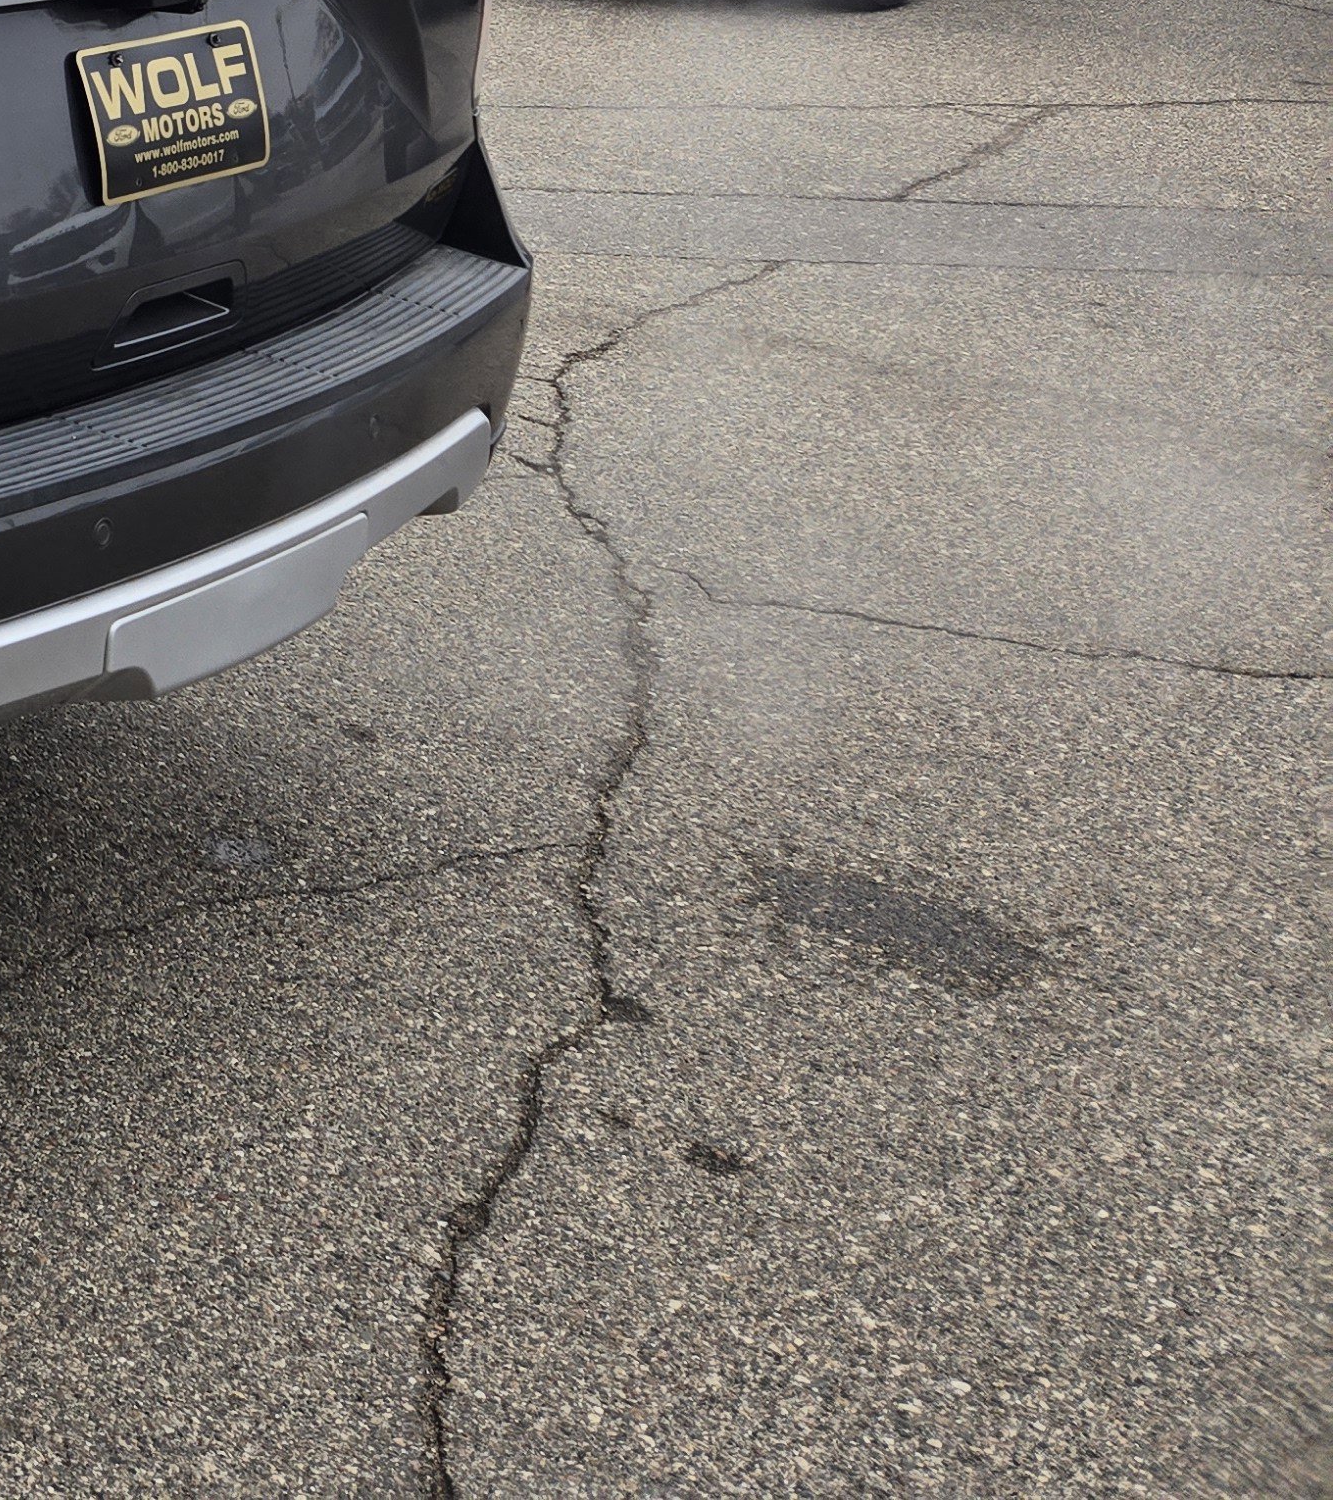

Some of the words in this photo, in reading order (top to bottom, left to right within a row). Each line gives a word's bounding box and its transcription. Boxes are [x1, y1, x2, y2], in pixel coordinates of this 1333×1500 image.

[90, 43, 247, 120] WOLF
[141, 102, 226, 143] MOTORS
[135, 129, 240, 164] www.wolfmotors.com
